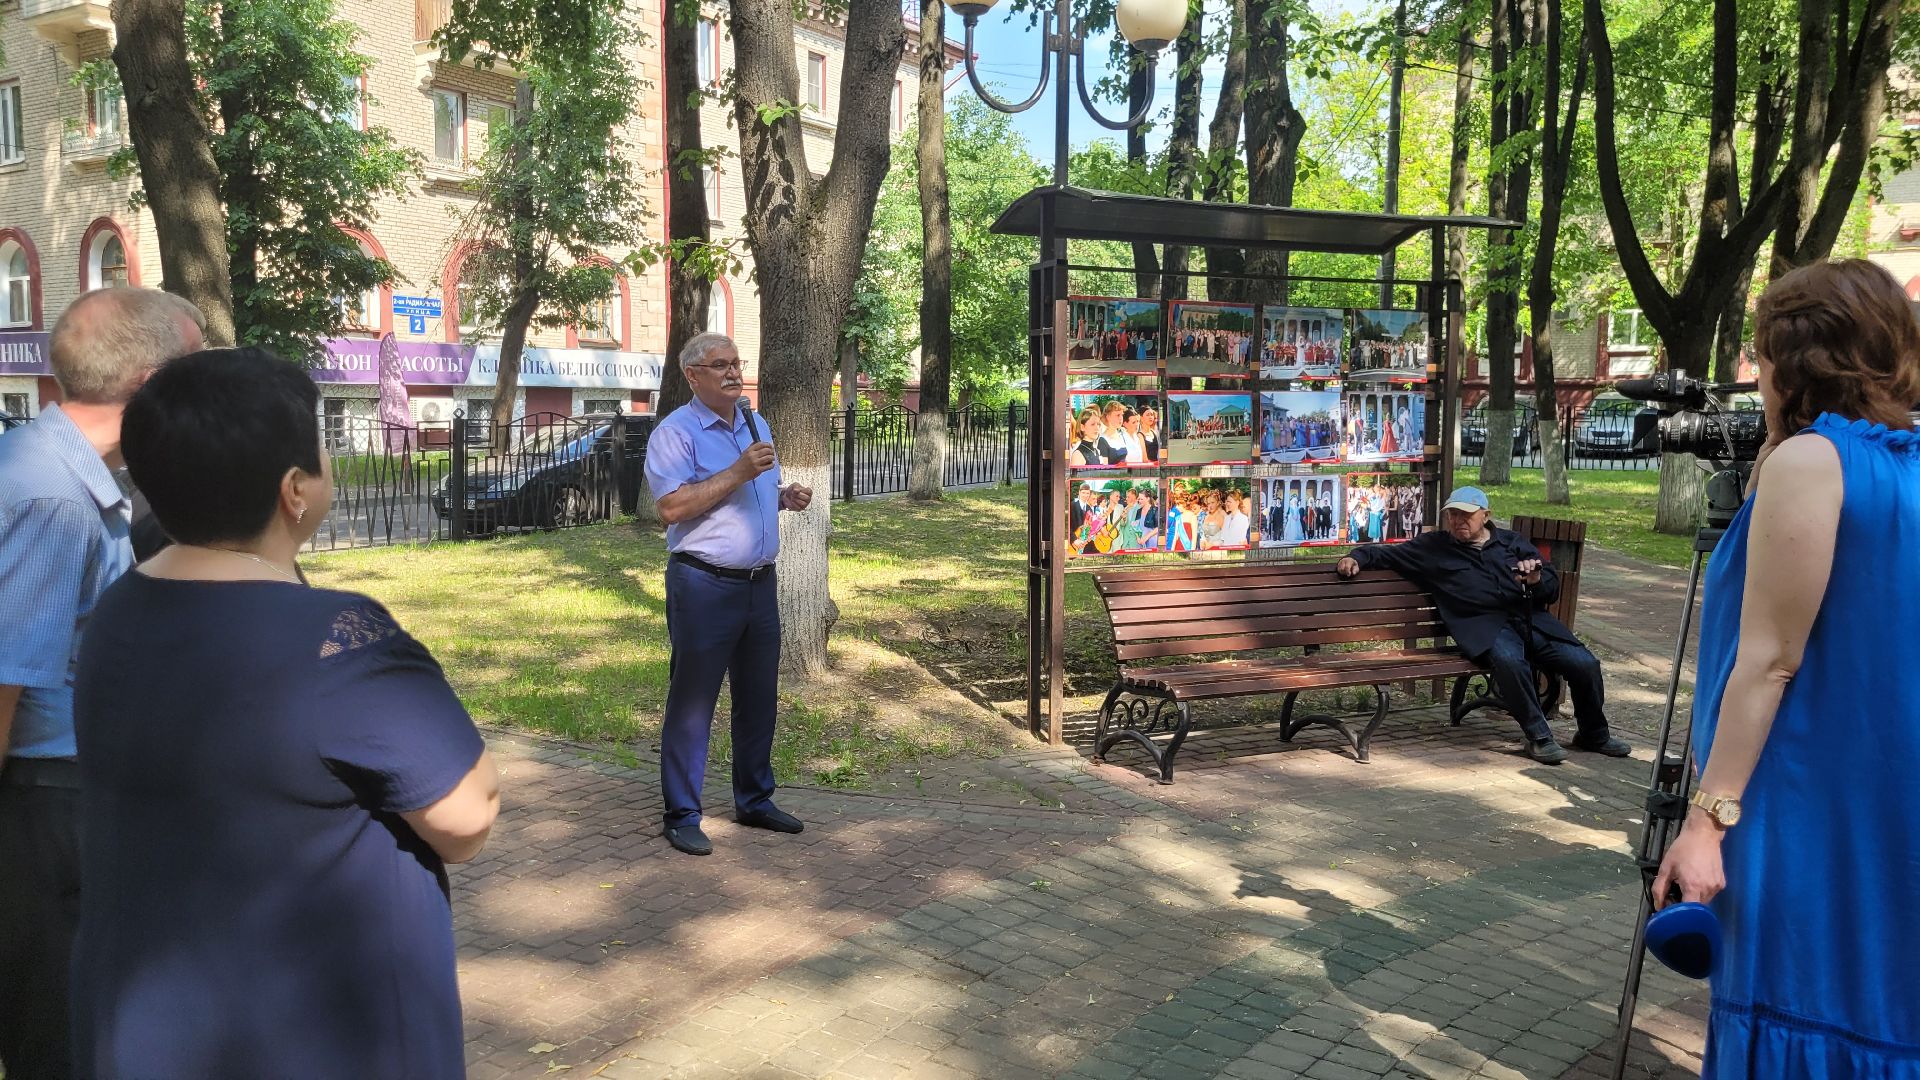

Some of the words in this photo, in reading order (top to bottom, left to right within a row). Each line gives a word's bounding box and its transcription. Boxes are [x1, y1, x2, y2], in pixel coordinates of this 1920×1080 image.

[414, 319, 422, 331] 2
[315, 353, 372, 371] АЛОН
[378, 354, 464, 373] АСОТЫ
[478, 359, 555, 375] КЛИКА
